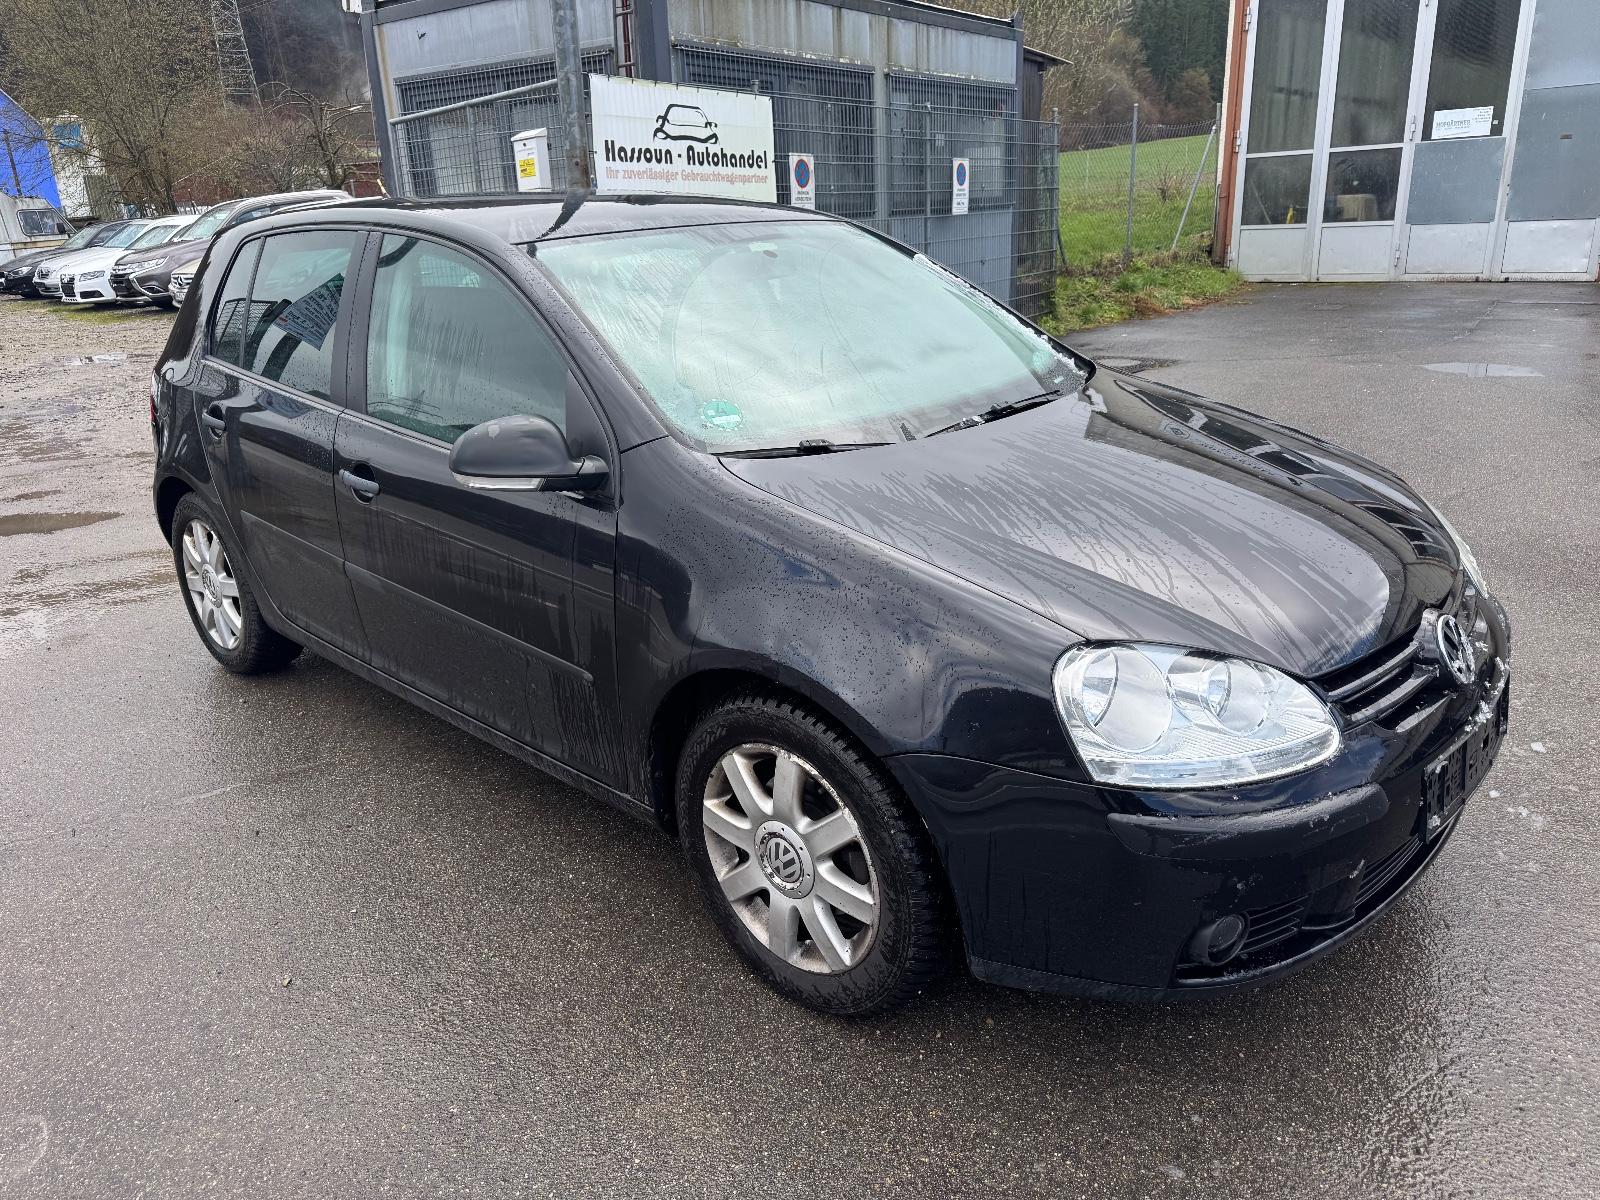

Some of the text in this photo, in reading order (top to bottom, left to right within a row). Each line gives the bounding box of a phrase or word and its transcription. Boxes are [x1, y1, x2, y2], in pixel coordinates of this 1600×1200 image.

[604, 139, 673, 164] Hassoun
[686, 144, 768, 169] Autohandel
[605, 166, 768, 185] Ihr zuverlässiger Gebrauchtwagenpartner
